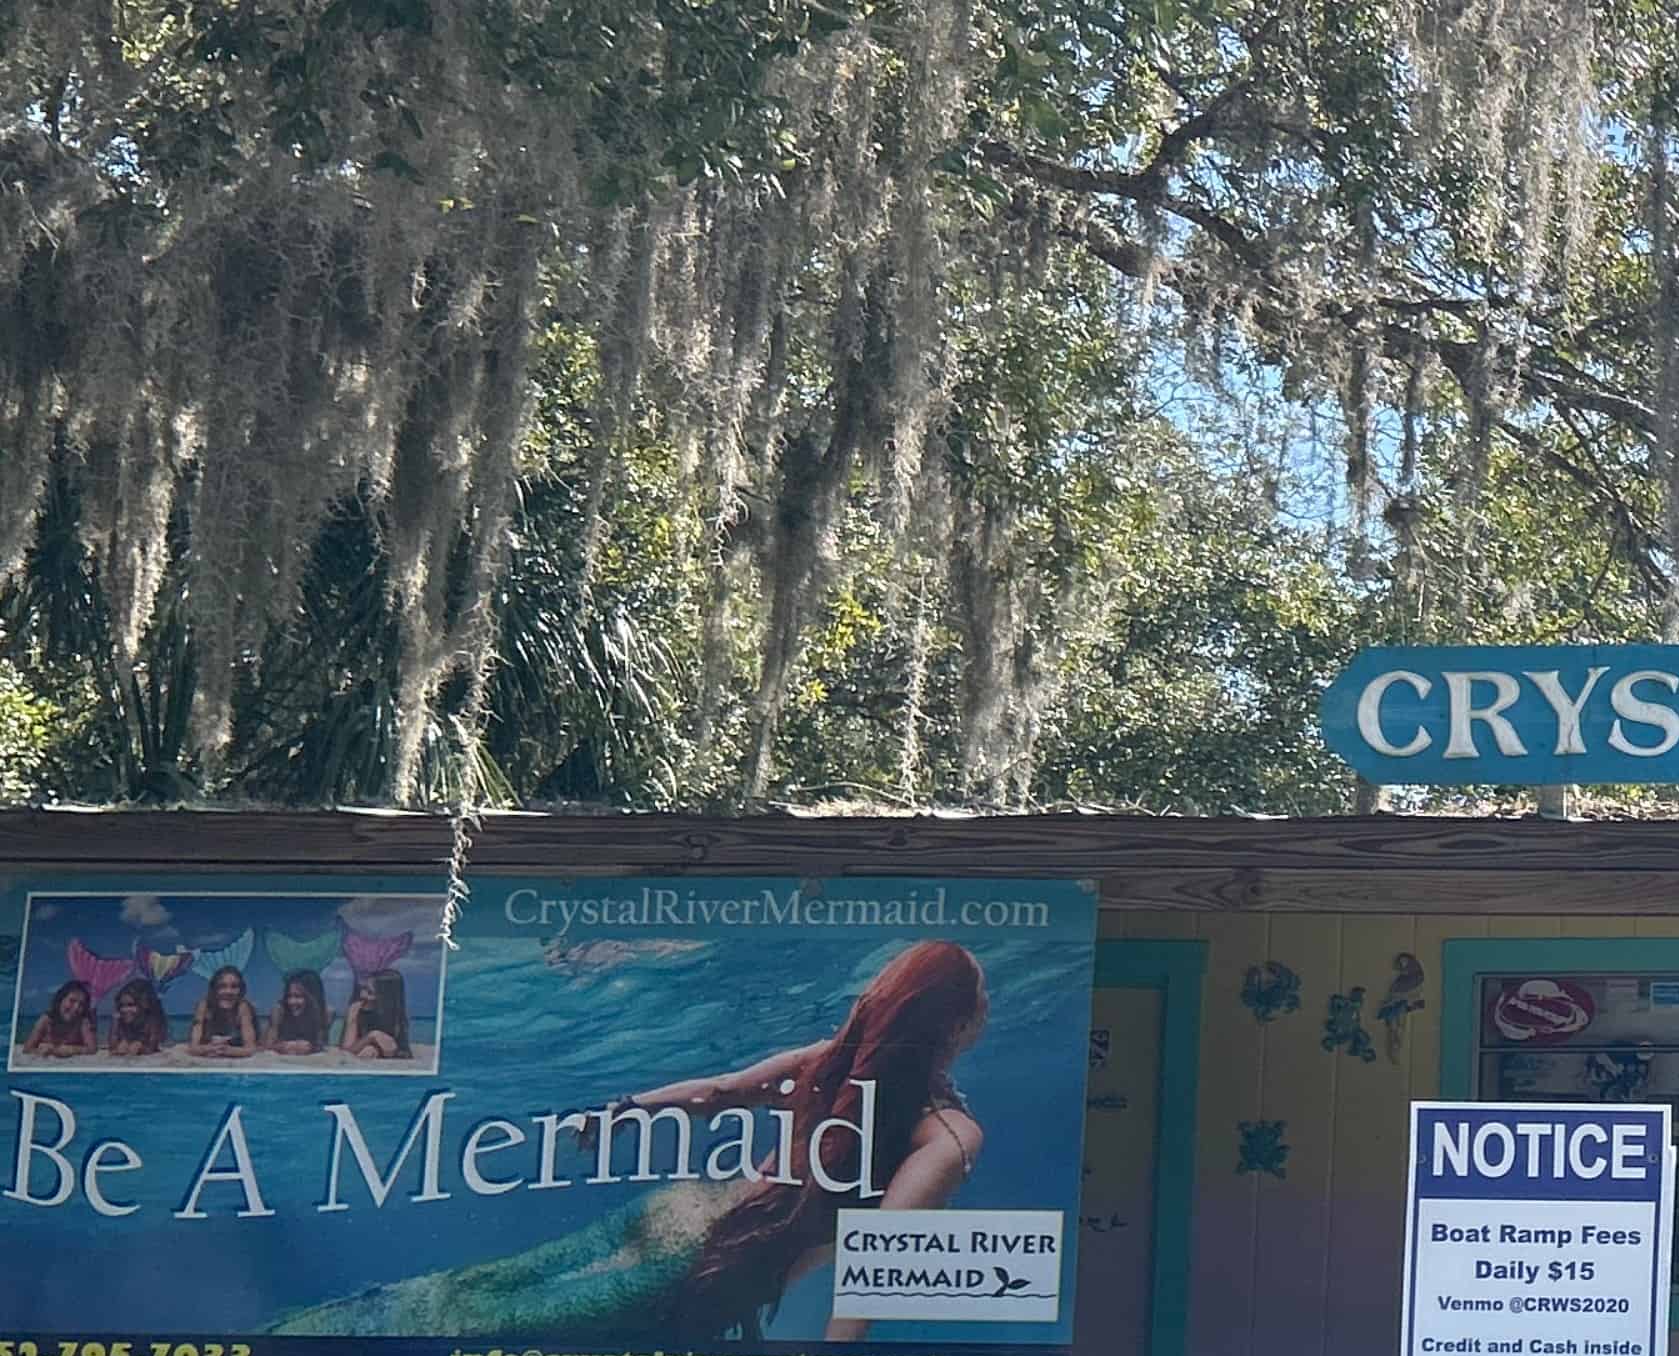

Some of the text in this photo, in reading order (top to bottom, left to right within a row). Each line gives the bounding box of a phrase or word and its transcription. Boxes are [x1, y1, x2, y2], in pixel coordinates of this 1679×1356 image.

[504, 887, 1050, 936] CrystalRiverMermaid.com
[2, 1079, 886, 1219] Be A Mermaid
[1432, 1121, 1648, 1180] NOTICE
[843, 1229, 1057, 1255] CRYSTAL RIVER
[1431, 1223, 1642, 1249] Boat Ramp Fees
[841, 1264, 985, 1288] MERMAID
[1474, 1260, 1596, 1284] Daily $15
[1437, 1295, 1630, 1315] Venmo @CRWS2020
[1421, 1337, 1643, 1356] Credit and Cash inside
